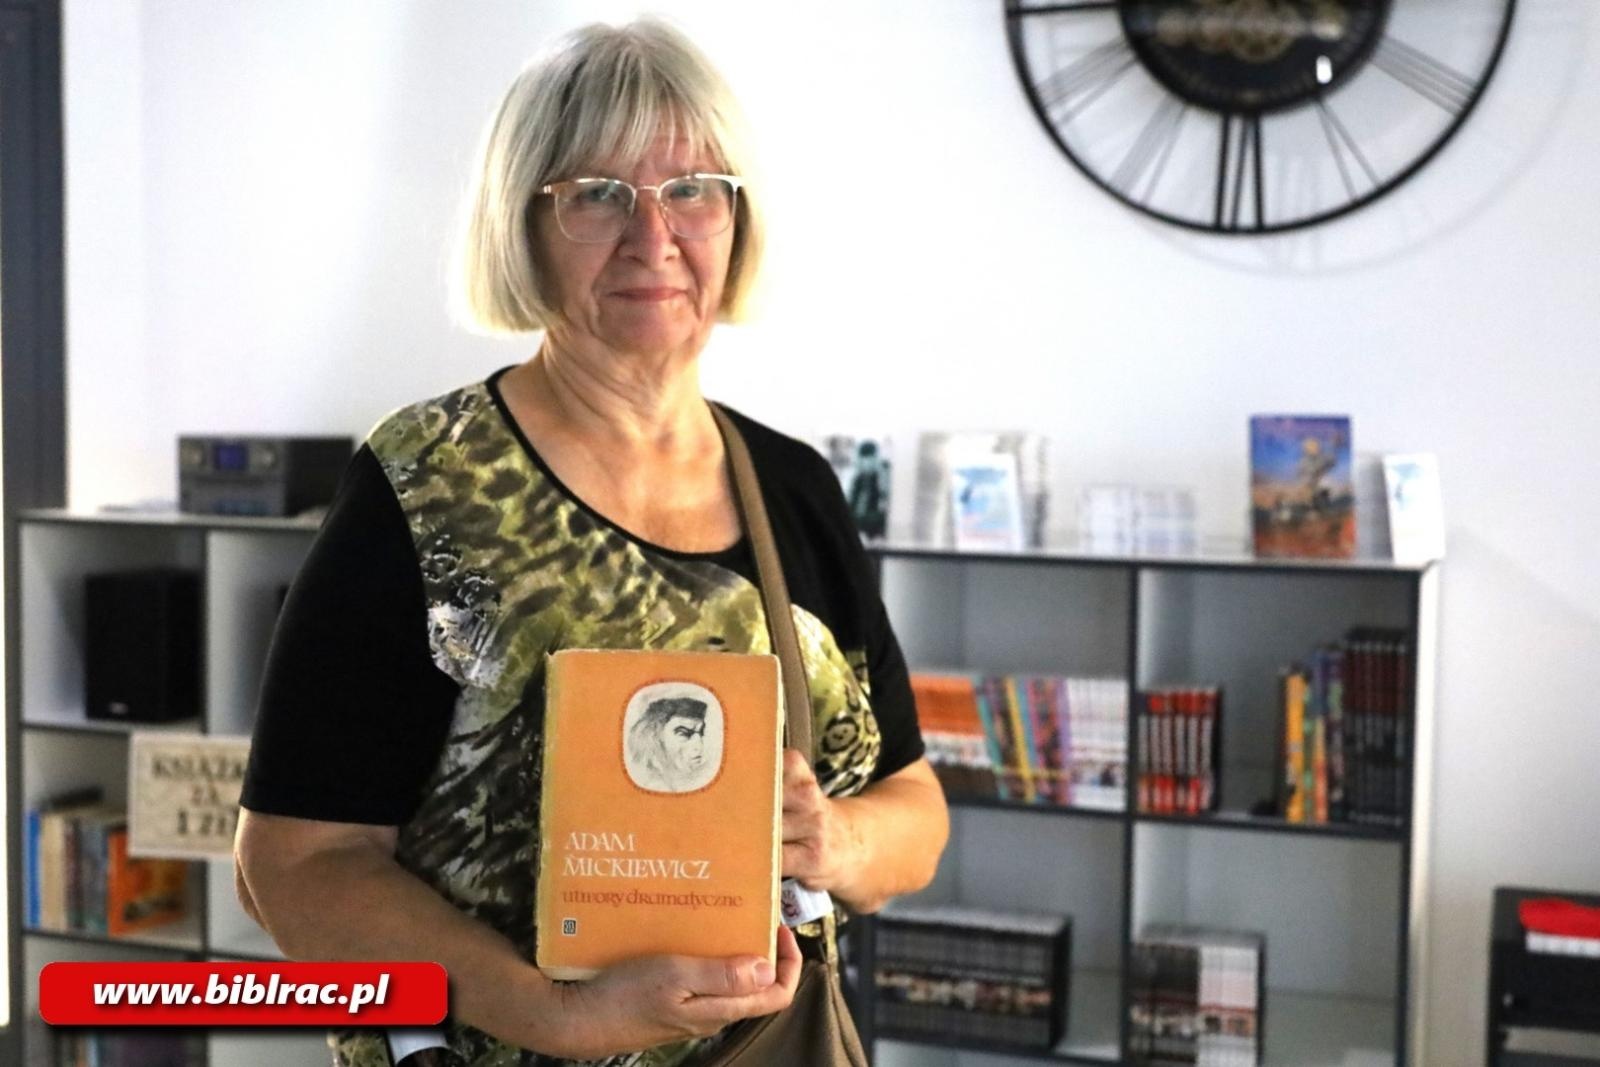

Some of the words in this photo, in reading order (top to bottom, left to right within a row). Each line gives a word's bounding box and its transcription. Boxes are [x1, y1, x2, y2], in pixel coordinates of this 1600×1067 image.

[565, 832, 635, 852] ADAM
[562, 856, 711, 880] MICKIEWICZ
[562, 890, 625, 908] utwory
[626, 889, 743, 911] dramatyczne
